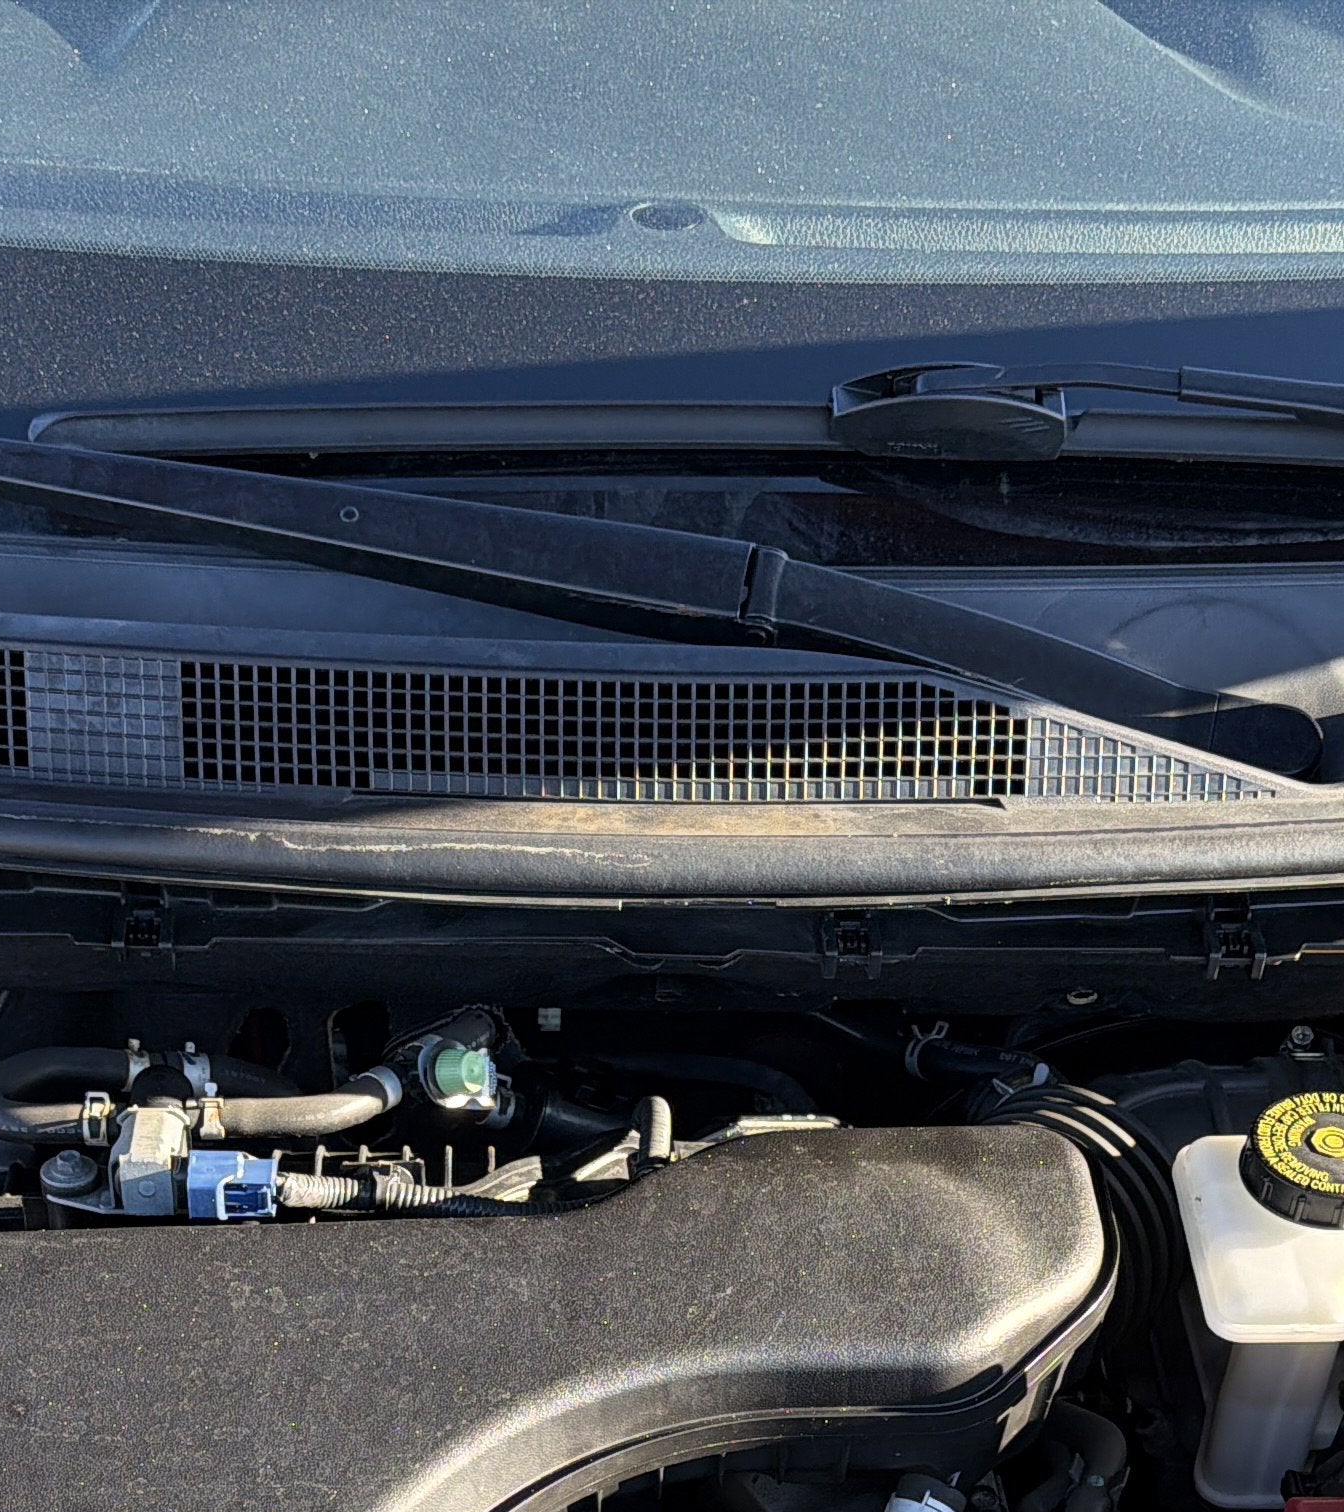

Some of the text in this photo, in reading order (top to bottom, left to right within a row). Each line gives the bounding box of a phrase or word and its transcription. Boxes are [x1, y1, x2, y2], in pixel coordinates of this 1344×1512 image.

[1322, 1092, 1337, 1103] OR
[1273, 1161, 1311, 1186] SEALED
[1281, 1151, 1329, 1181] REMOVING
